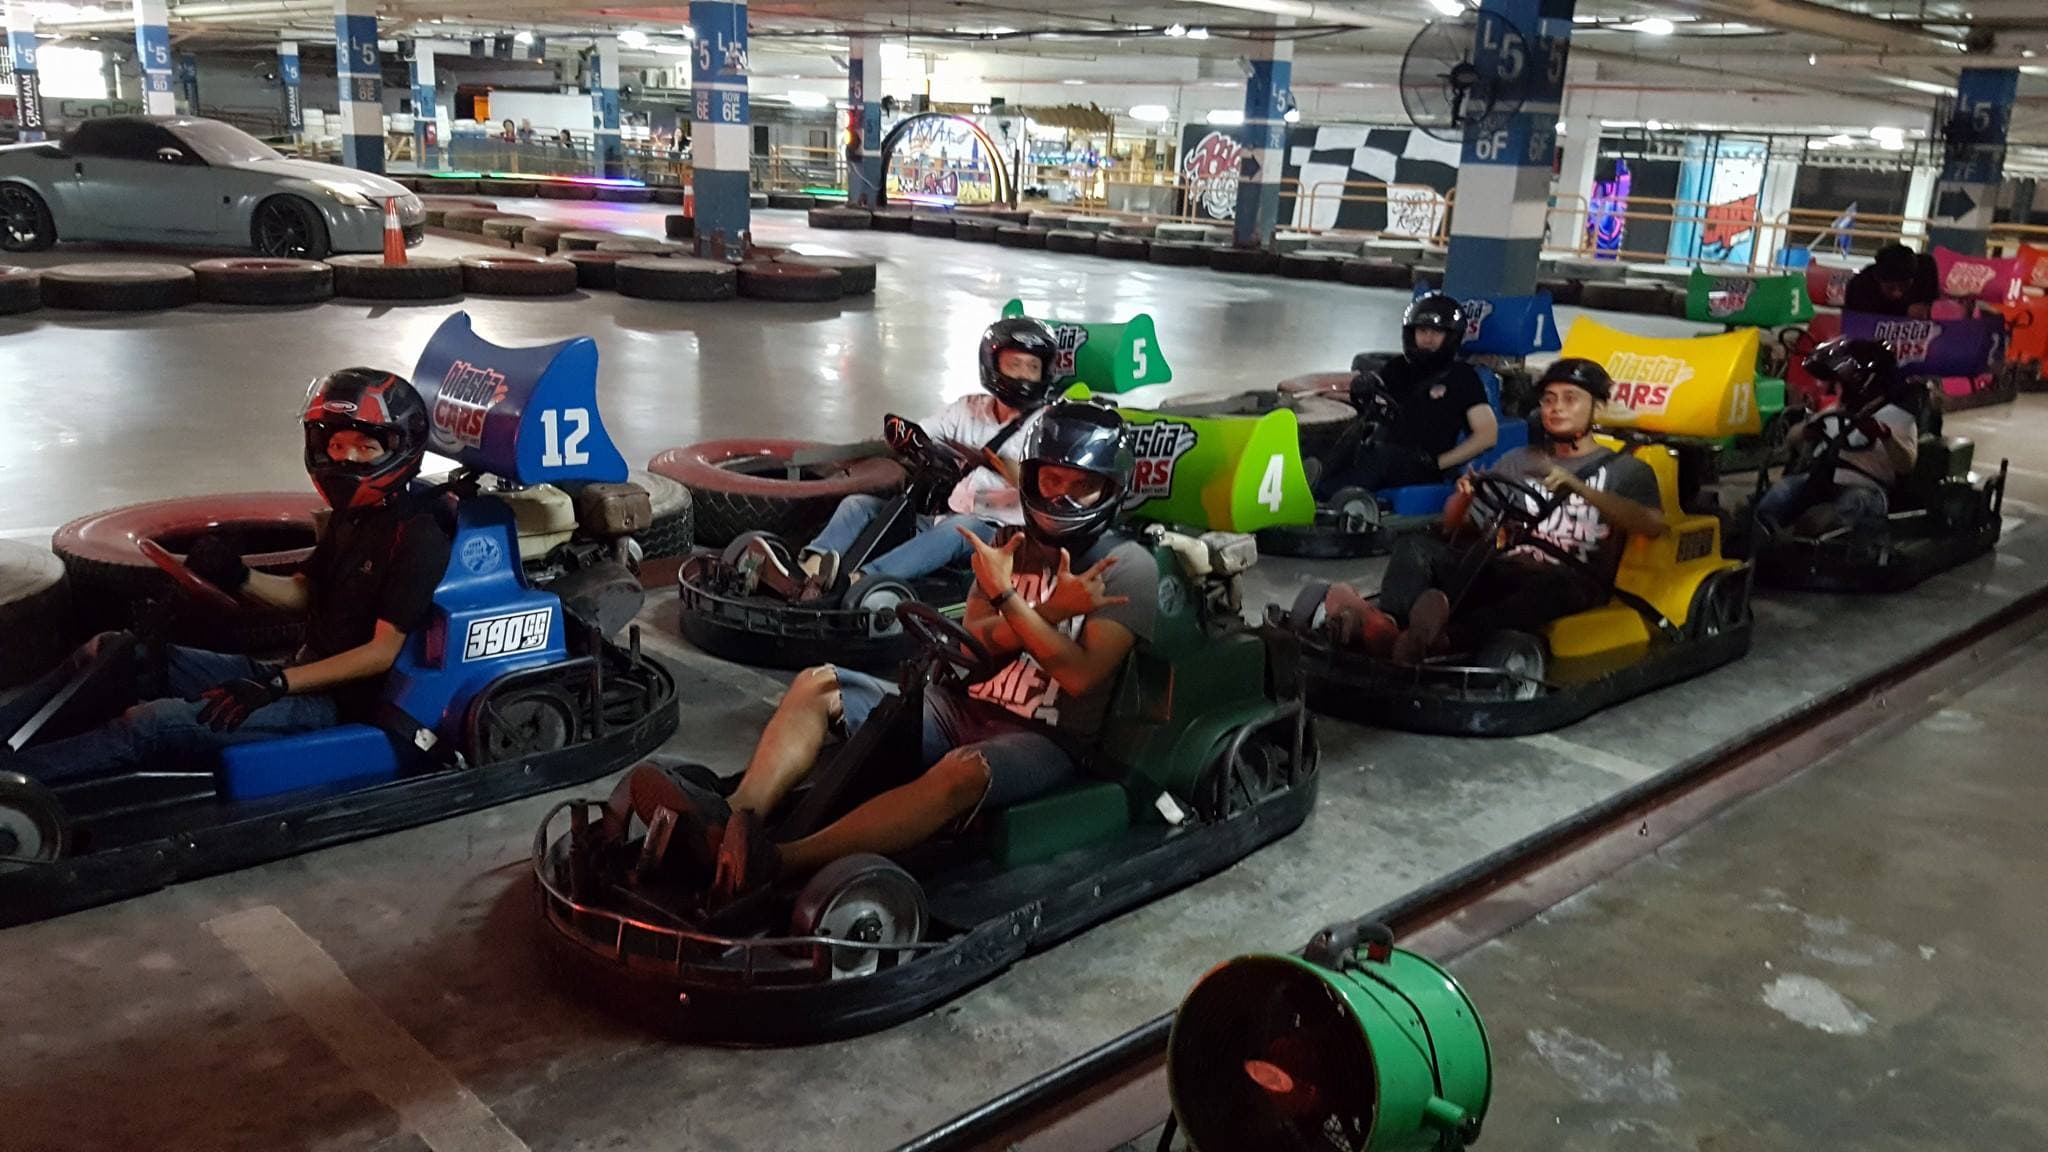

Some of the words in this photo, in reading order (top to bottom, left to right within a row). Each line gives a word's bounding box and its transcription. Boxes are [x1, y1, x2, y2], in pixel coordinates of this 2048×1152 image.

[722, 102, 741, 122] 6E
[1533, 313, 1545, 348] 1
[1132, 337, 1148, 380] 5
[1604, 382, 1668, 410] ARS
[540, 407, 590, 468] 12
[1257, 453, 1284, 512] 4
